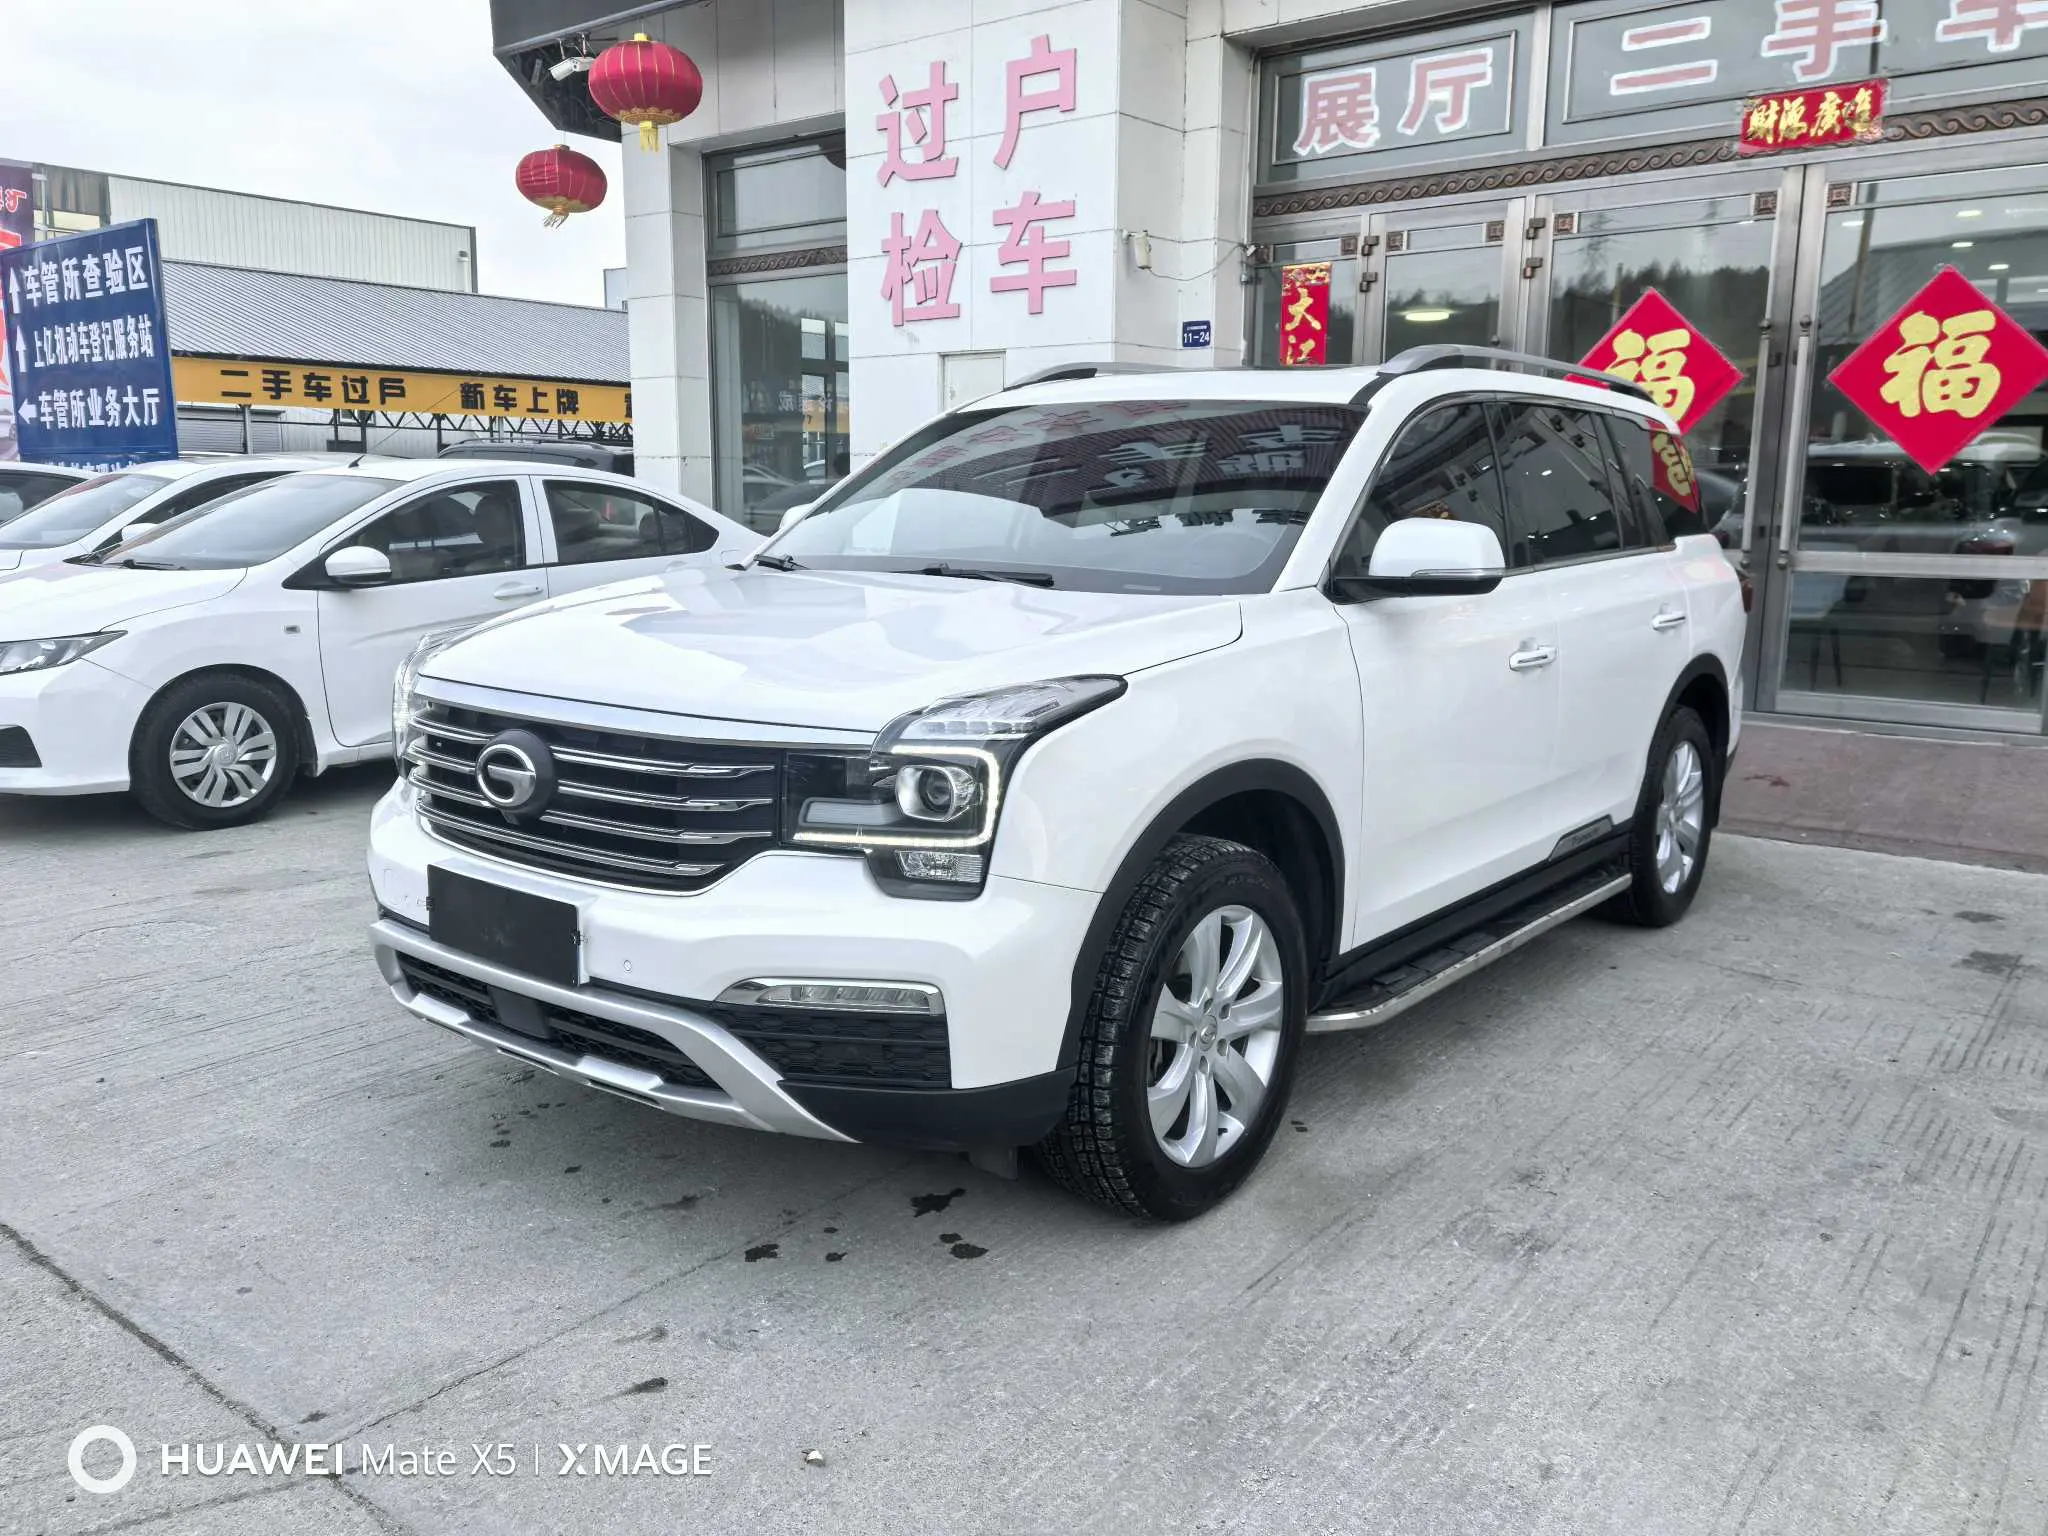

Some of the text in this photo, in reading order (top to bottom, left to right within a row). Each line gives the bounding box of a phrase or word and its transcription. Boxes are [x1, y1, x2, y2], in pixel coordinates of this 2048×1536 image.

[876, 33, 1077, 188] 过户
[1293, 47, 1493, 156] 展厅
[23, 246, 149, 308] 车管所查验区
[881, 190, 1077, 327] 检车
[34, 313, 155, 368] 上亿机动车登记服务站
[1183, 331, 1210, 344] 11-24
[1880, 310, 2001, 418] 福
[38, 385, 161, 430] 车管所业务大厅
[220, 369, 580, 416] 二手车过户 新车上牌
